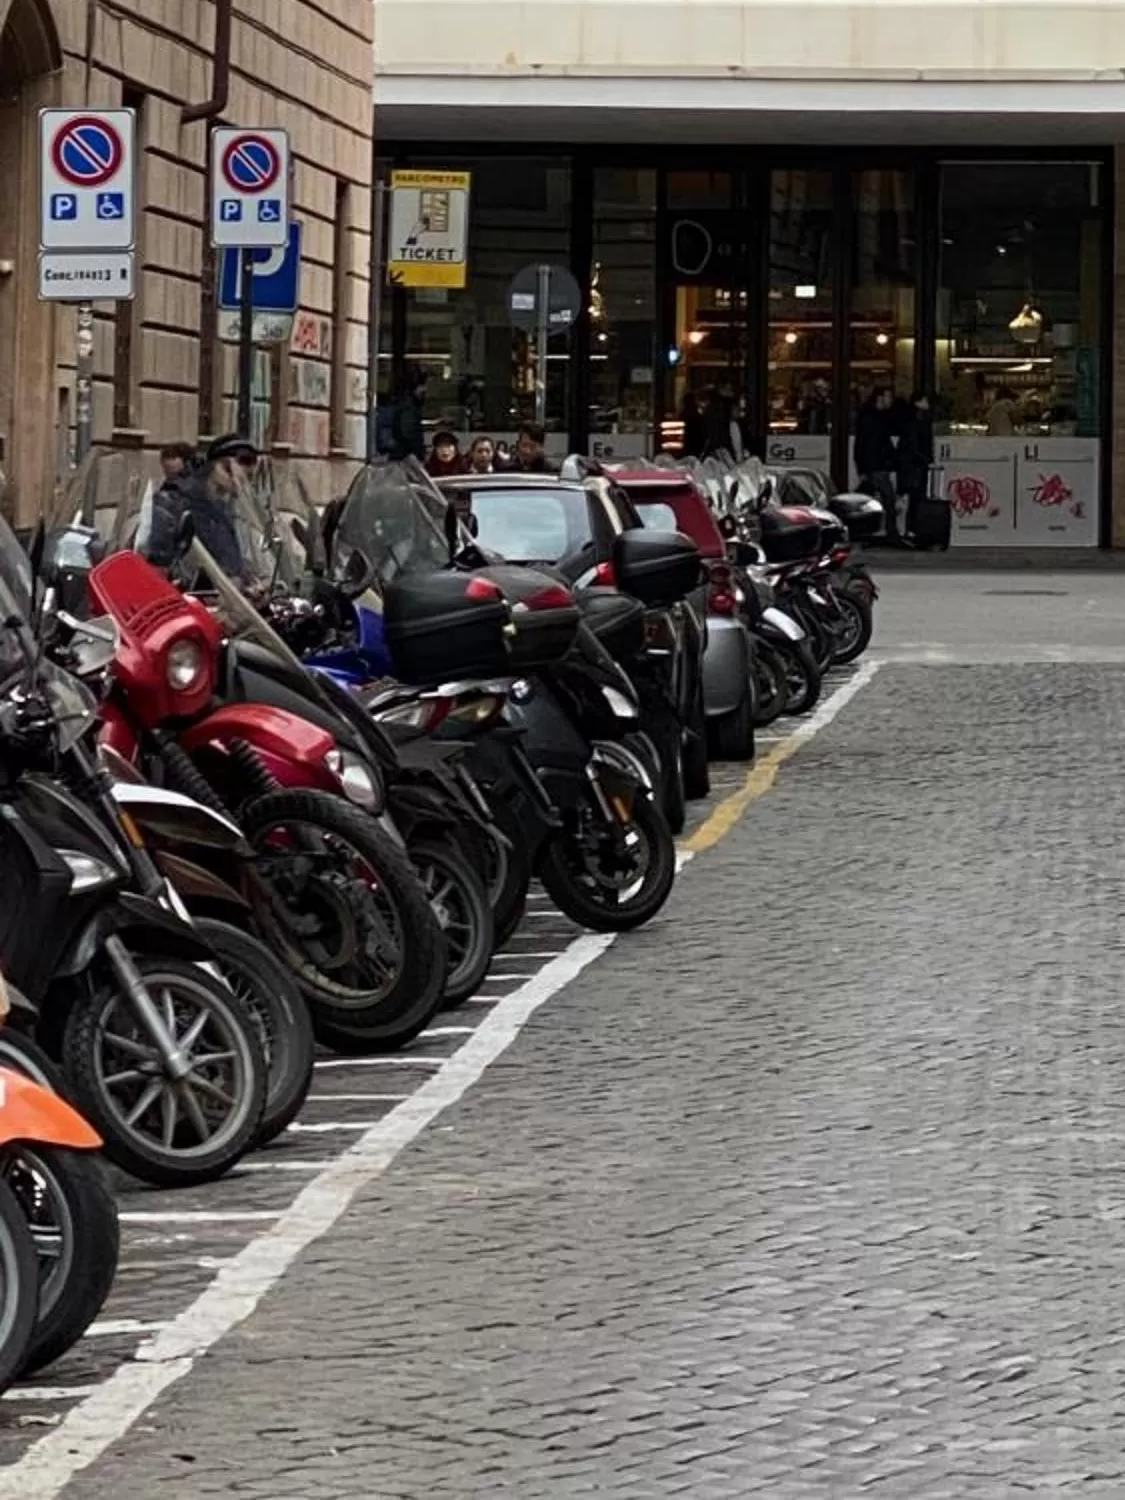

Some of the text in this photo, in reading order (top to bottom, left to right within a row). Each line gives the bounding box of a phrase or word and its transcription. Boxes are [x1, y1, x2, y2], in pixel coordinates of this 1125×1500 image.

[55, 195, 72, 218] P
[224, 201, 238, 219] P
[400, 247, 456, 261] TICKET
[770, 443, 796, 461] Gg
